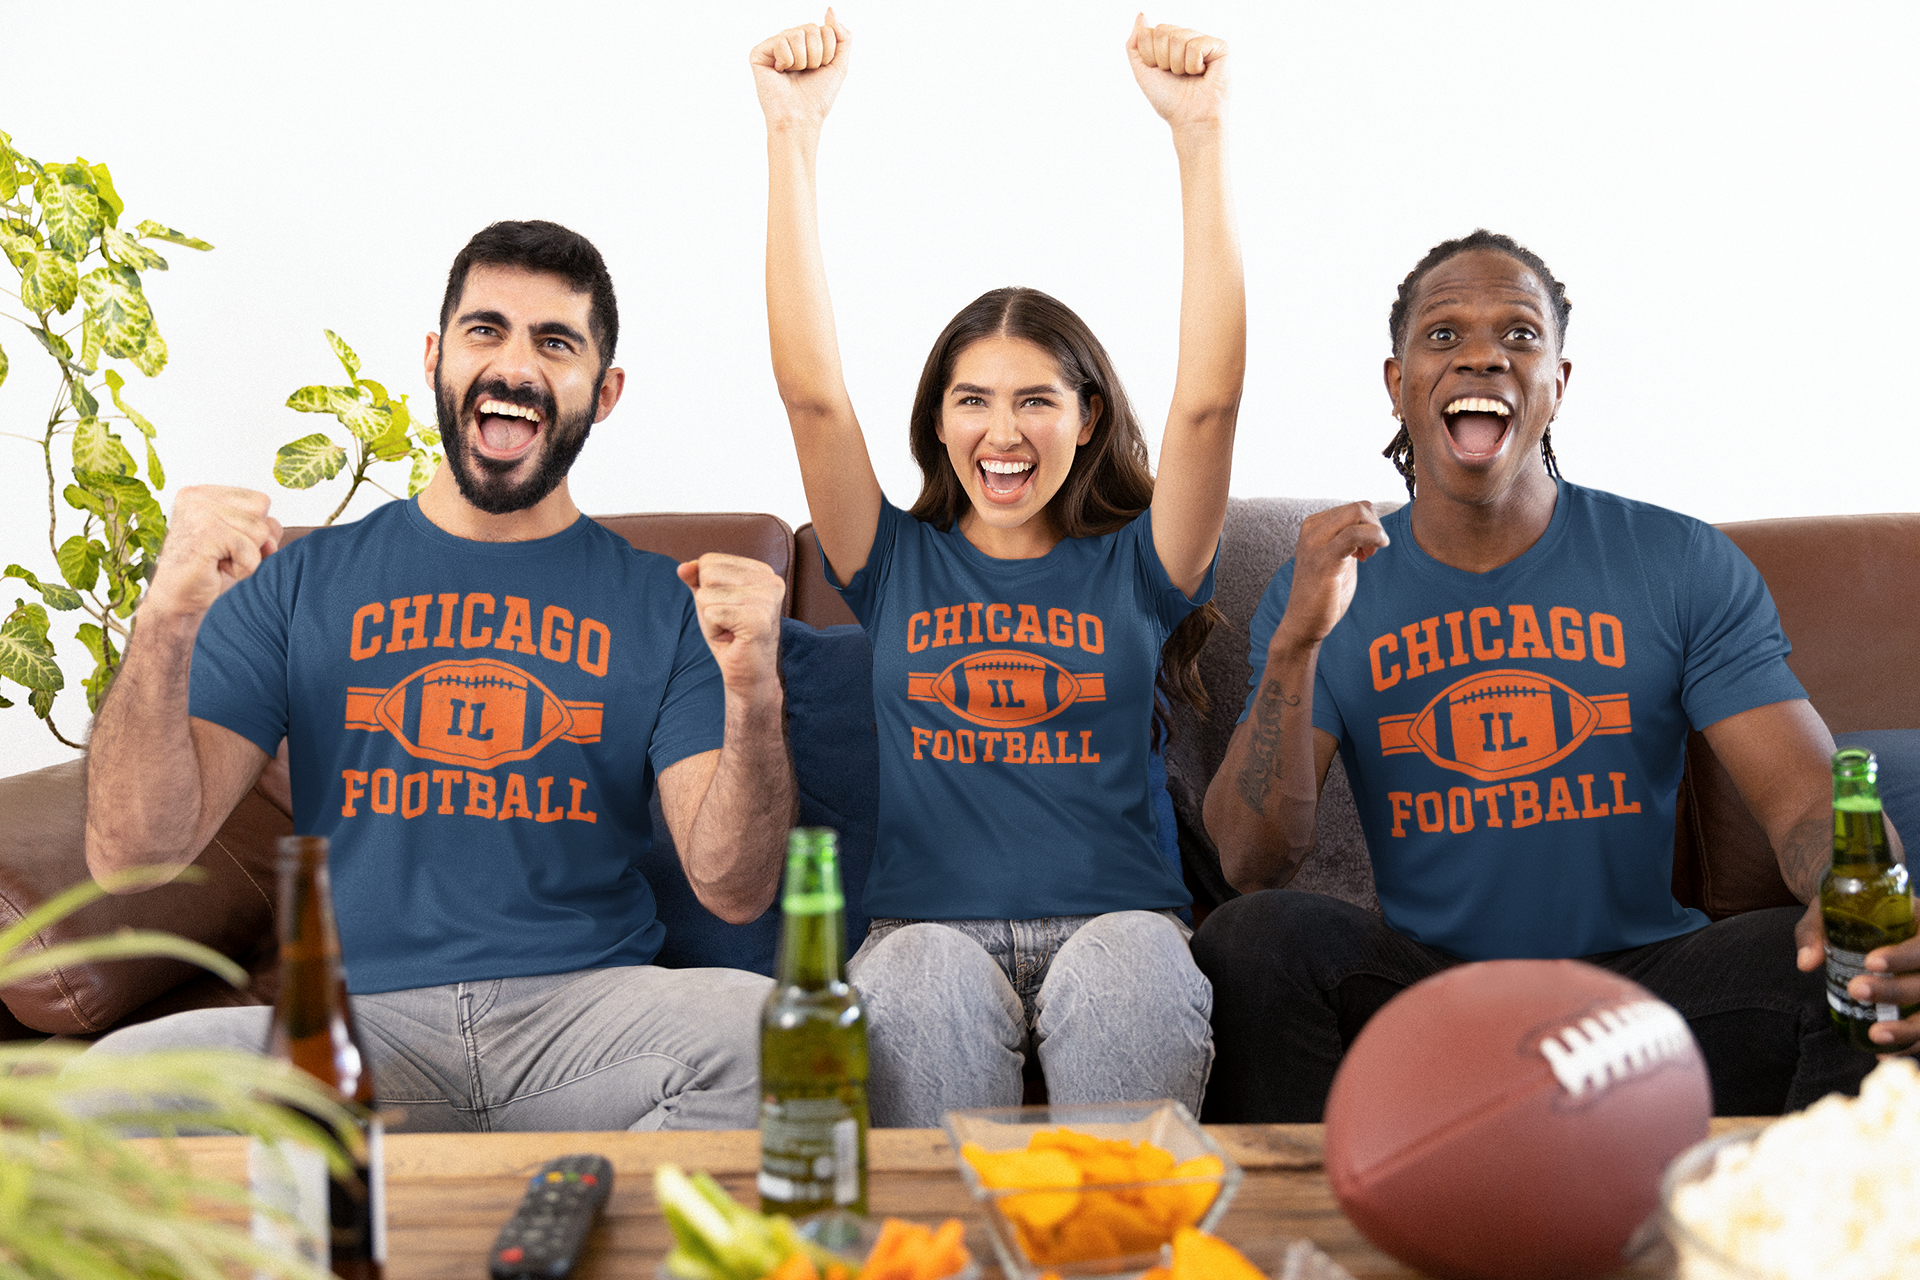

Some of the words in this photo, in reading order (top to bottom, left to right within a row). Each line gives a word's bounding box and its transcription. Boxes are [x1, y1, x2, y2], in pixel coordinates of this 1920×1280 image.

[350, 592, 611, 678] CHICAGO
[907, 602, 1105, 655] CHICAGO
[1369, 604, 1626, 692] CHICAGO
[447, 698, 494, 742] IL
[987, 679, 1026, 708] IL
[911, 726, 1100, 764] FOOTBALL
[1479, 712, 1528, 752] IL
[342, 768, 598, 824] FOOTBALL
[1388, 772, 1641, 838] FOOTBALL
